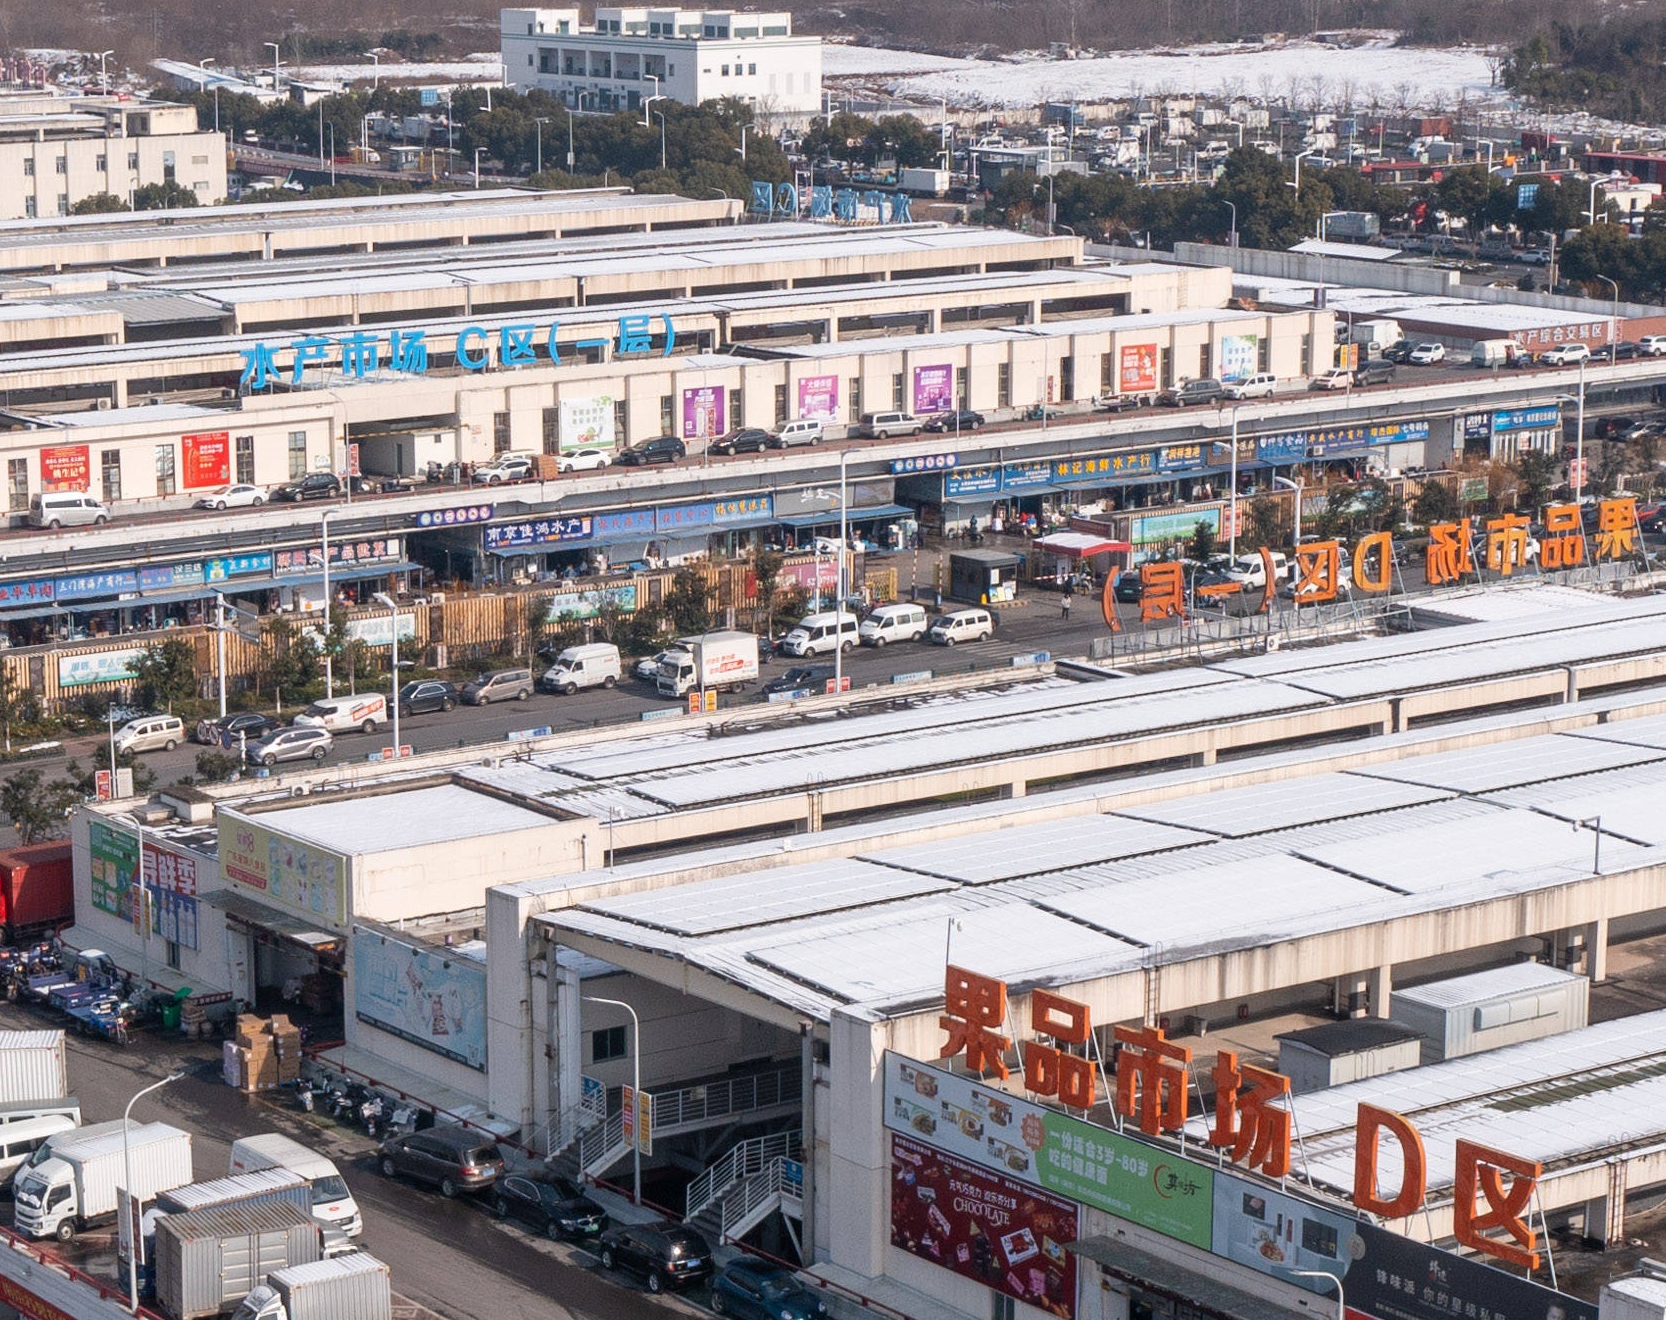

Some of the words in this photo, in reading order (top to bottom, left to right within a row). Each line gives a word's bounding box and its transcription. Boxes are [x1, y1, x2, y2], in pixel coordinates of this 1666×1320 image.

[241, 331, 427, 389] 水产市场
[940, 965, 1292, 1178] 果品市场
[1354, 1101, 1542, 1270] D区
[952, 1196, 1011, 1228] CHOCOLATE
